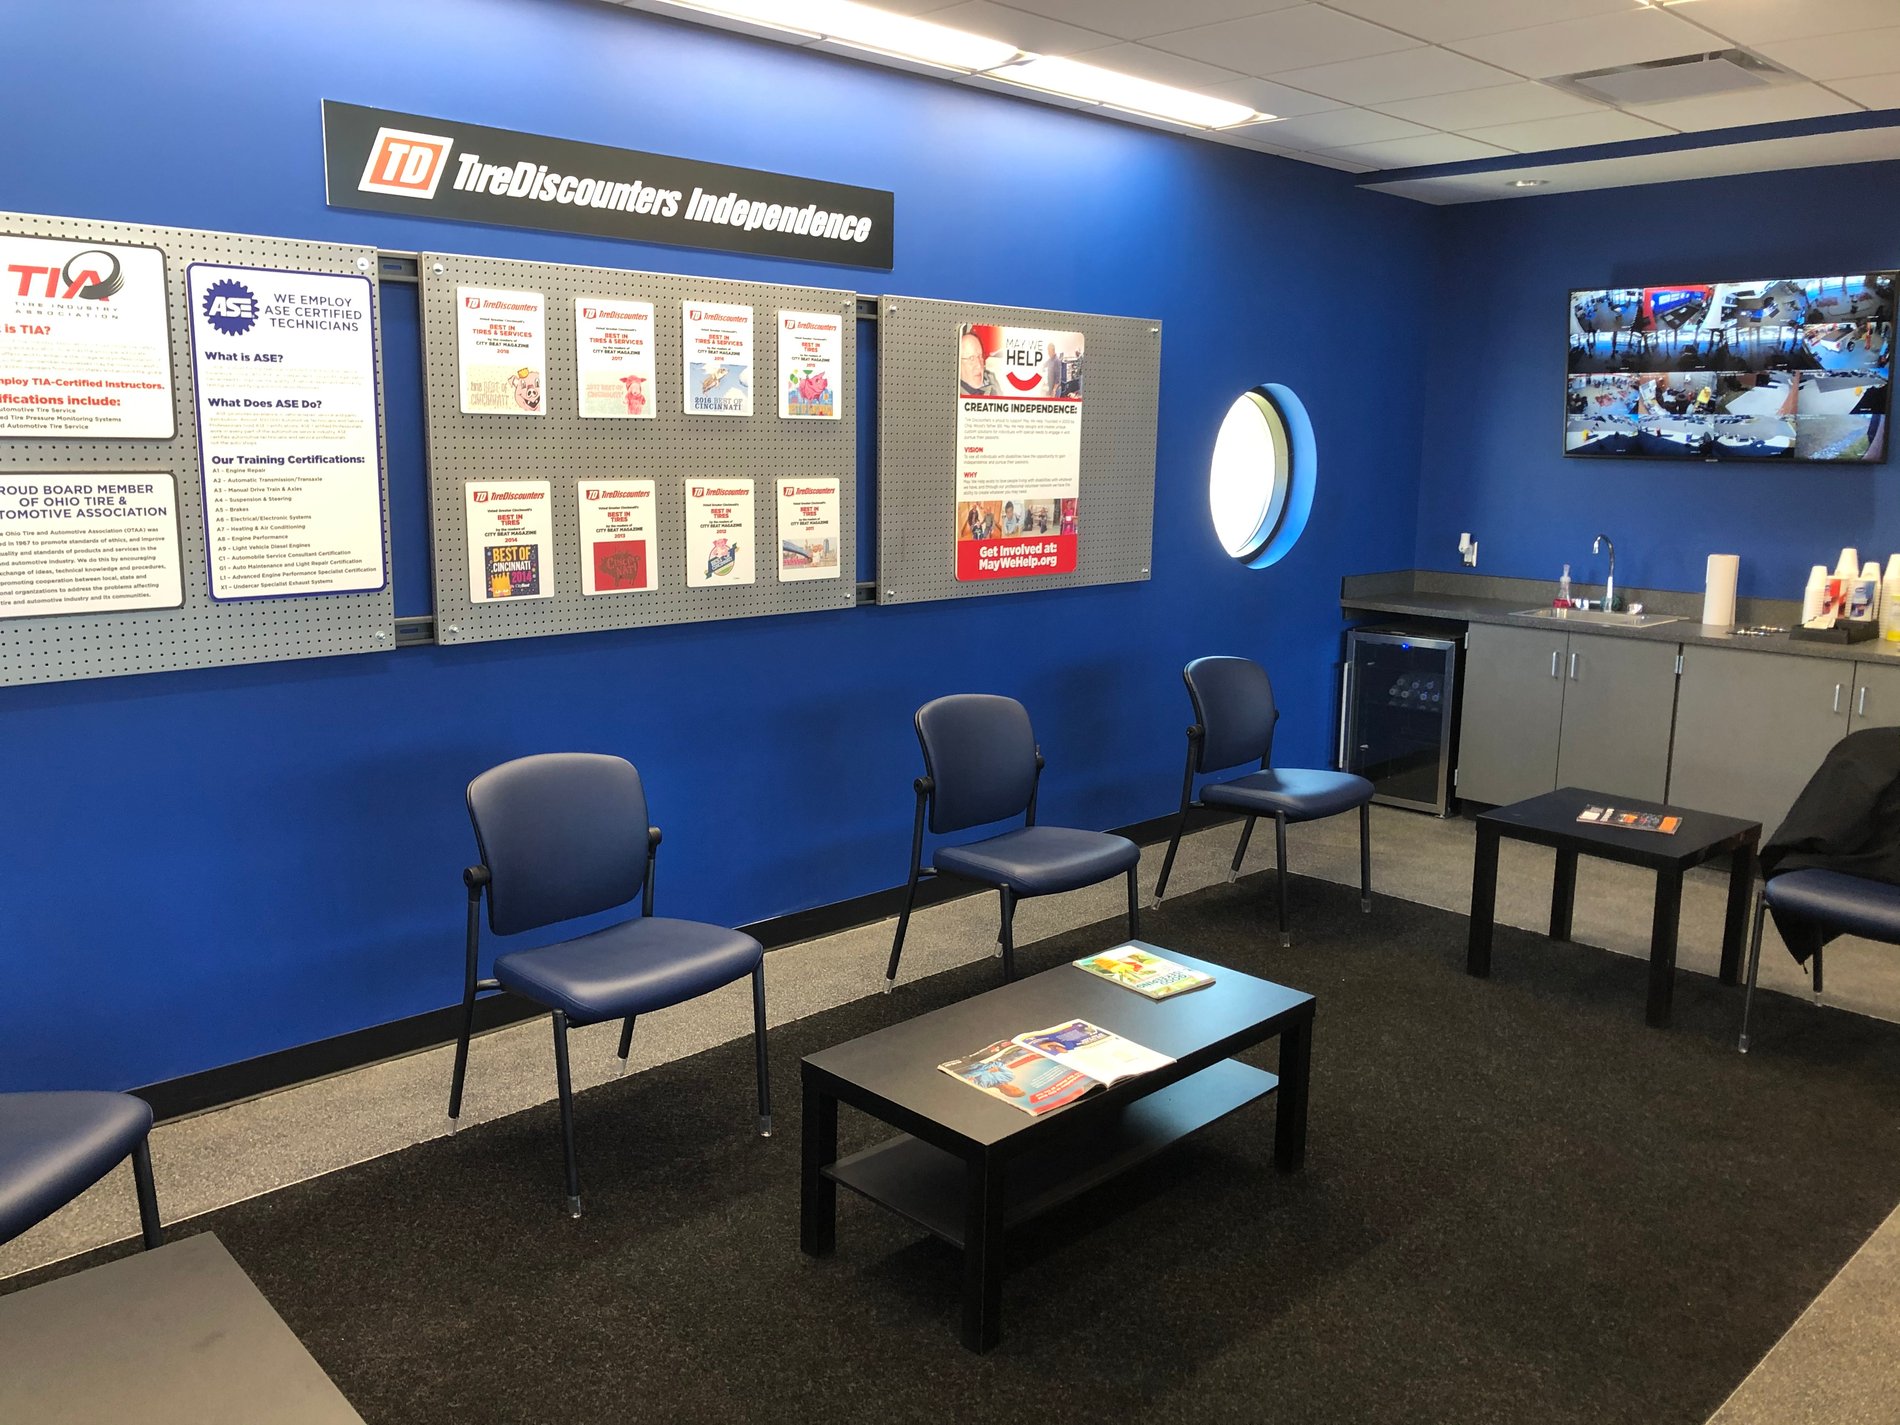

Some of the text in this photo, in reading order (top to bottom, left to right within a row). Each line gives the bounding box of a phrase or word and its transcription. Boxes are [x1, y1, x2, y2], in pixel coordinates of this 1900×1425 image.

[381, 142, 872, 243] TD TireDiscounters Independence
[7, 264, 110, 301] TIA
[274, 293, 352, 307] WE EMPLOY
[51, 304, 118, 312] INDUSTRY
[208, 296, 254, 319] ASE
[483, 300, 538, 312] TireDiscounters
[15, 309, 119, 319] ASSOCIATION
[265, 305, 362, 320] ASE CERTIFIED
[599, 310, 648, 320] TireDiscounters
[5, 324, 51, 335] is TIA?
[269, 318, 359, 332] TECHNICIANS
[500, 330, 532, 338] SERVICES
[1006, 338, 1043, 351] MAY WE
[205, 351, 283, 363] What is ASE?
[1006, 349, 1043, 367] HELP
[32, 377, 103, 388] TIA-Certified
[105, 380, 165, 390] Instructors.
[67, 395, 121, 406] include:
[208, 398, 322, 409] What Does ASE Do?
[694, 403, 741, 411] CINCINNATI
[964, 402, 1077, 414] CREATING INDEPENDENCE:
[56, 415, 93, 423] Monitoring
[211, 454, 365, 465] Our Training Certifications:
[43, 485, 93, 495] BOARD
[97, 484, 153, 494] MEMBER
[602, 490, 650, 499] TireDiscounters
[19, 496, 127, 507] OF OHIO TIRE &
[491, 492, 545, 501] TireDiscounters
[76, 507, 167, 518] ASSOCIATION
[493, 546, 531, 562] BEST OF
[980, 543, 1057, 558] Get Involved at:
[493, 561, 531, 572] CINCINNATI
[979, 555, 1057, 571] MayWeHelp.org
[511, 570, 532, 583] 2014
